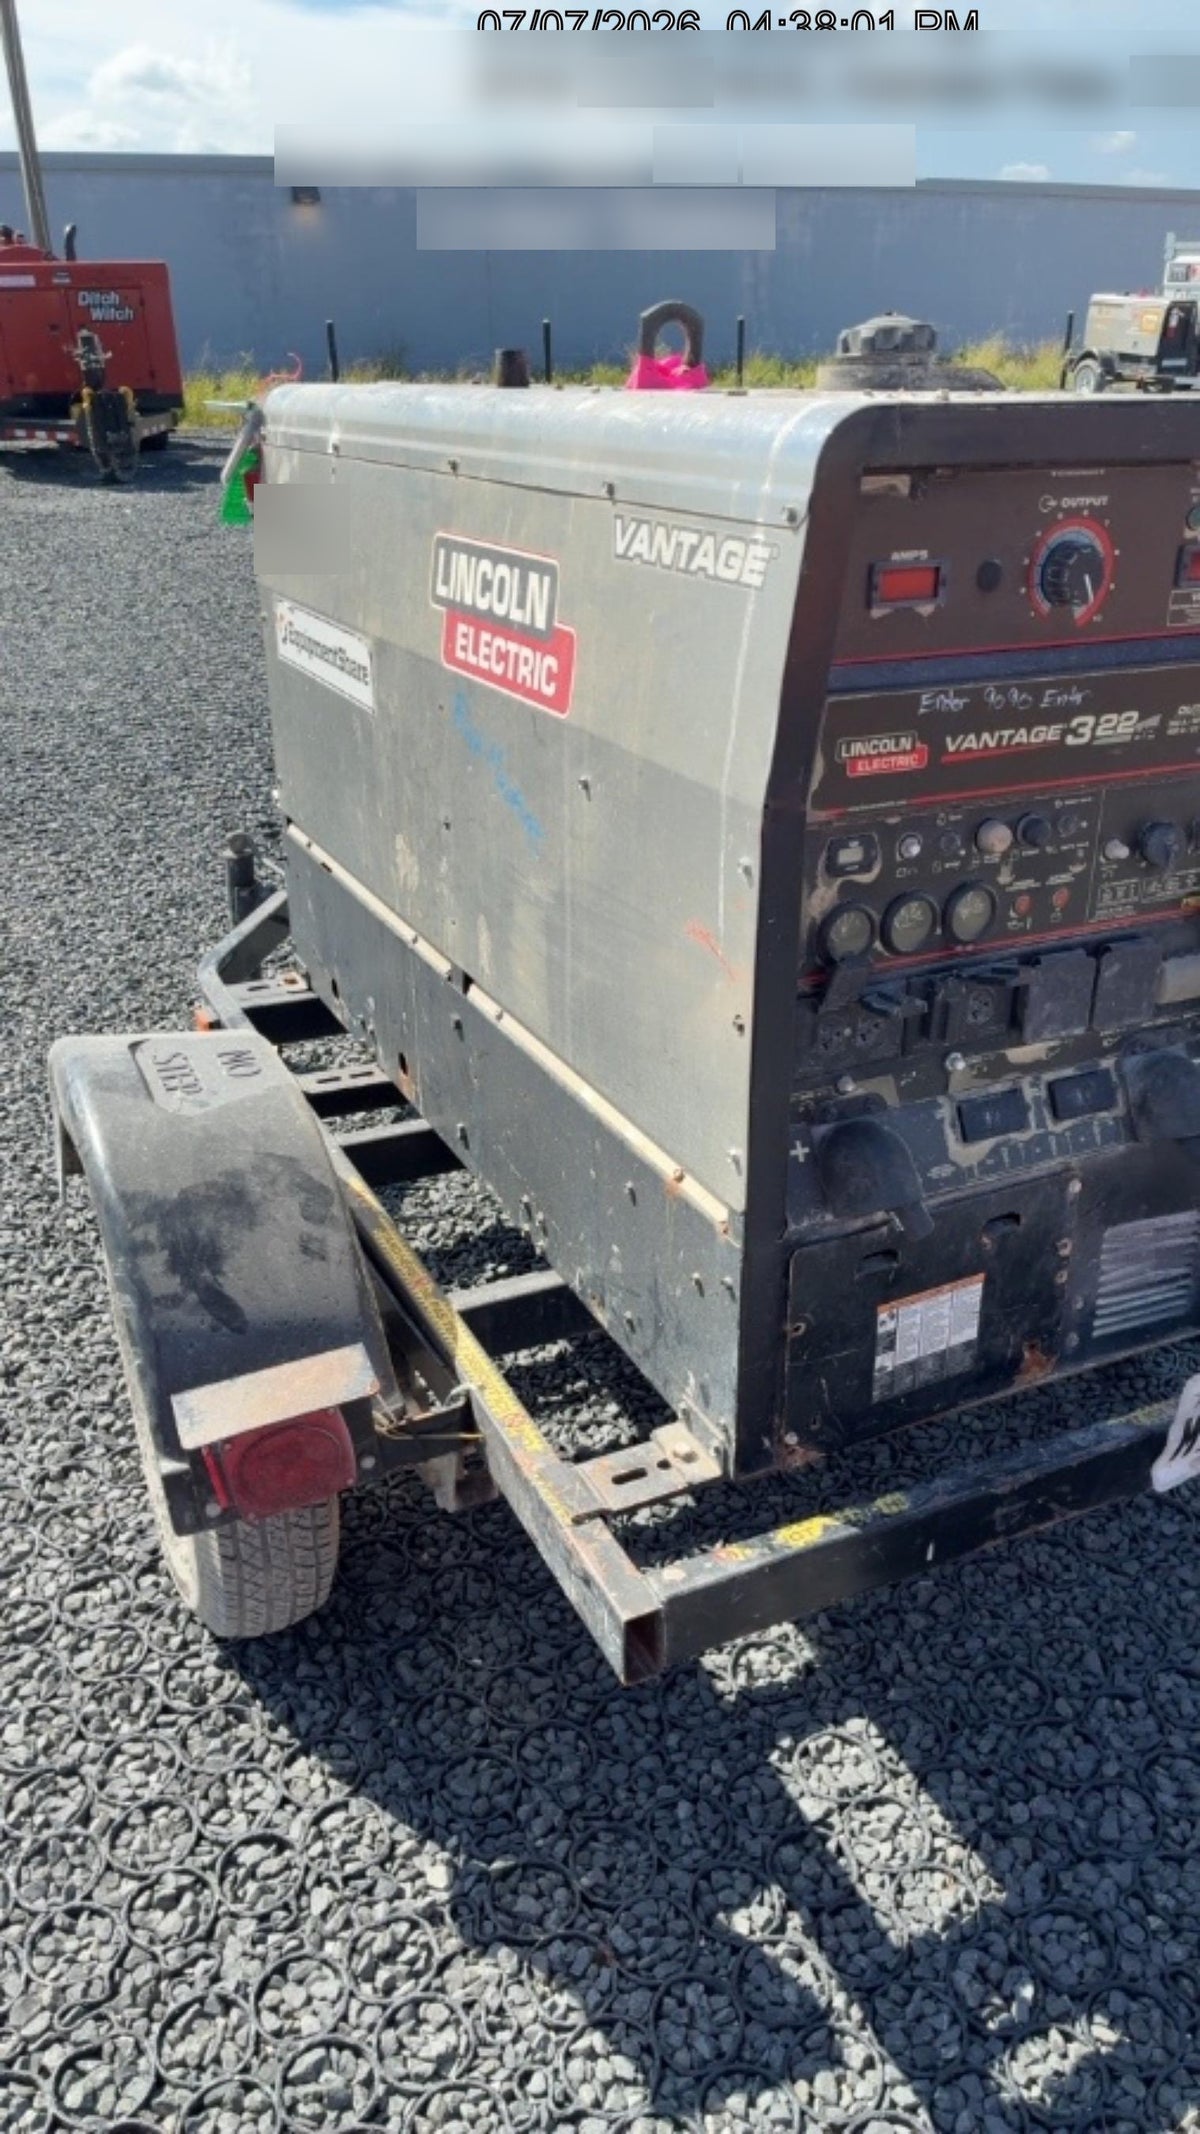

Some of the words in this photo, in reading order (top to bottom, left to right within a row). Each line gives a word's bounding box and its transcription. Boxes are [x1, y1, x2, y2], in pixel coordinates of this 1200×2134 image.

[78, 291, 119, 306] Ditch
[90, 305, 134, 321] Witch
[1061, 496, 1108, 508] OUTPUT
[614, 516, 771, 588] VANTAGE
[891, 550, 928, 561] AMPS
[437, 547, 551, 631] LINCOLN
[288, 629, 369, 687] EquipmentShare
[456, 622, 558, 697] ELECTRIC
[945, 723, 1064, 753] VANTAGE
[1065, 711, 1139, 746] 322
[841, 736, 914, 758] LINCOLN
[857, 753, 919, 772] ELECTRIC
